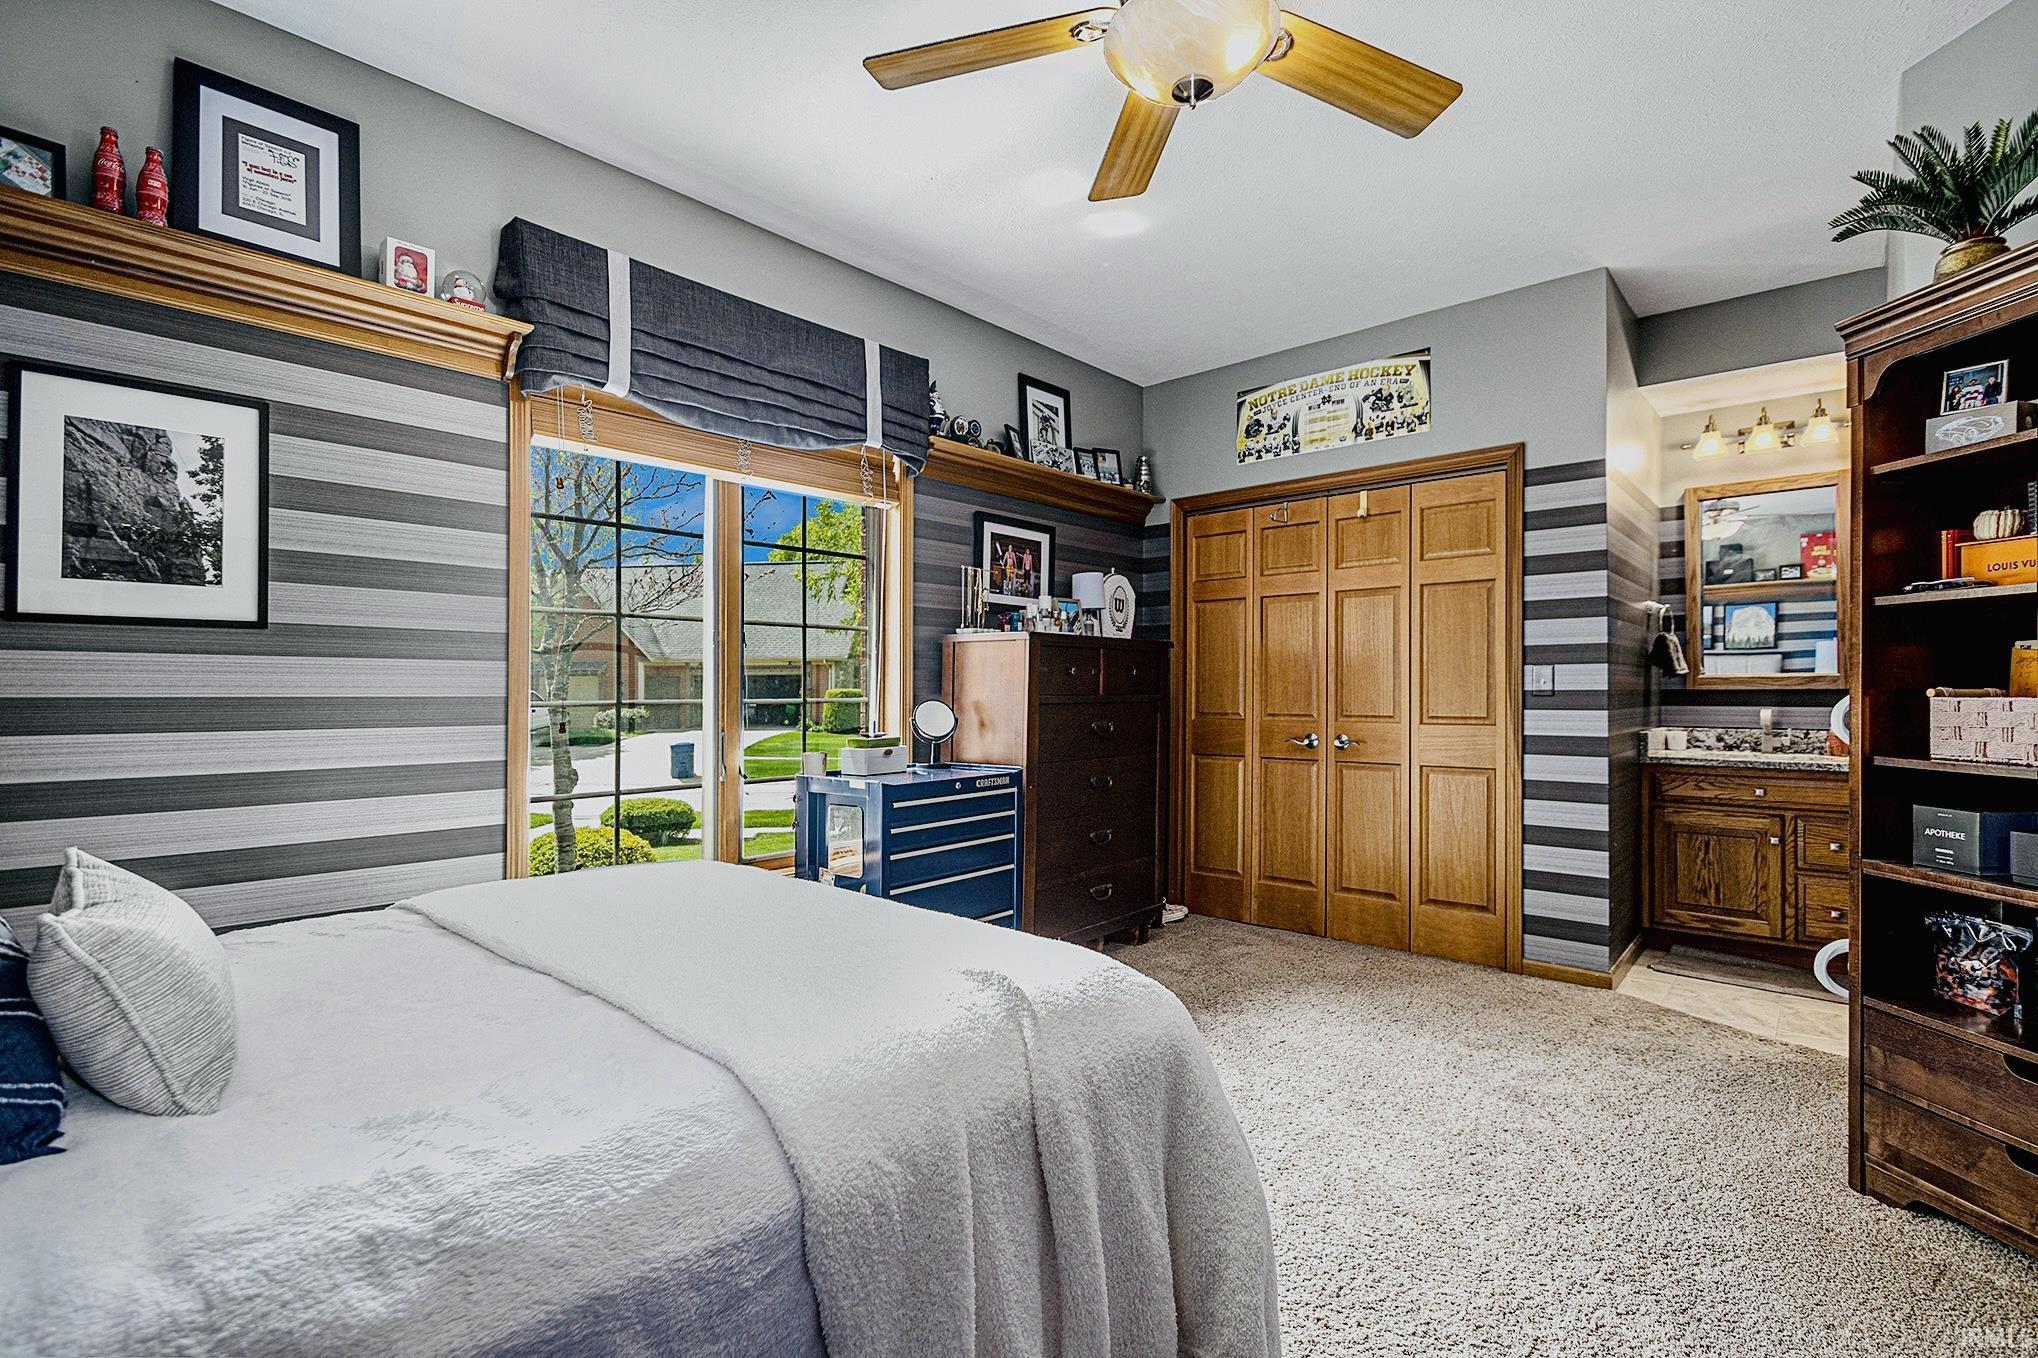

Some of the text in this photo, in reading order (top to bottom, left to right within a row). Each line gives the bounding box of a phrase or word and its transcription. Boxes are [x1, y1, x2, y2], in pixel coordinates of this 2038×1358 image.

[453, 298, 485, 312] Supreme
[1247, 383, 1297, 411] NOTRE
[1299, 371, 1345, 393] DAME
[1347, 364, 1417, 382] HOCKEY
[1262, 398, 1288, 414] JOYCE
[1349, 381, 1361, 389] OF
[1363, 379, 1377, 388] AN
[1380, 377, 1398, 386] ERA
[1987, 559, 2038, 573] LOUIS VU
[975, 776, 1010, 788] CRAFTSMAN
[1924, 828, 1967, 841] APOTHEKE
